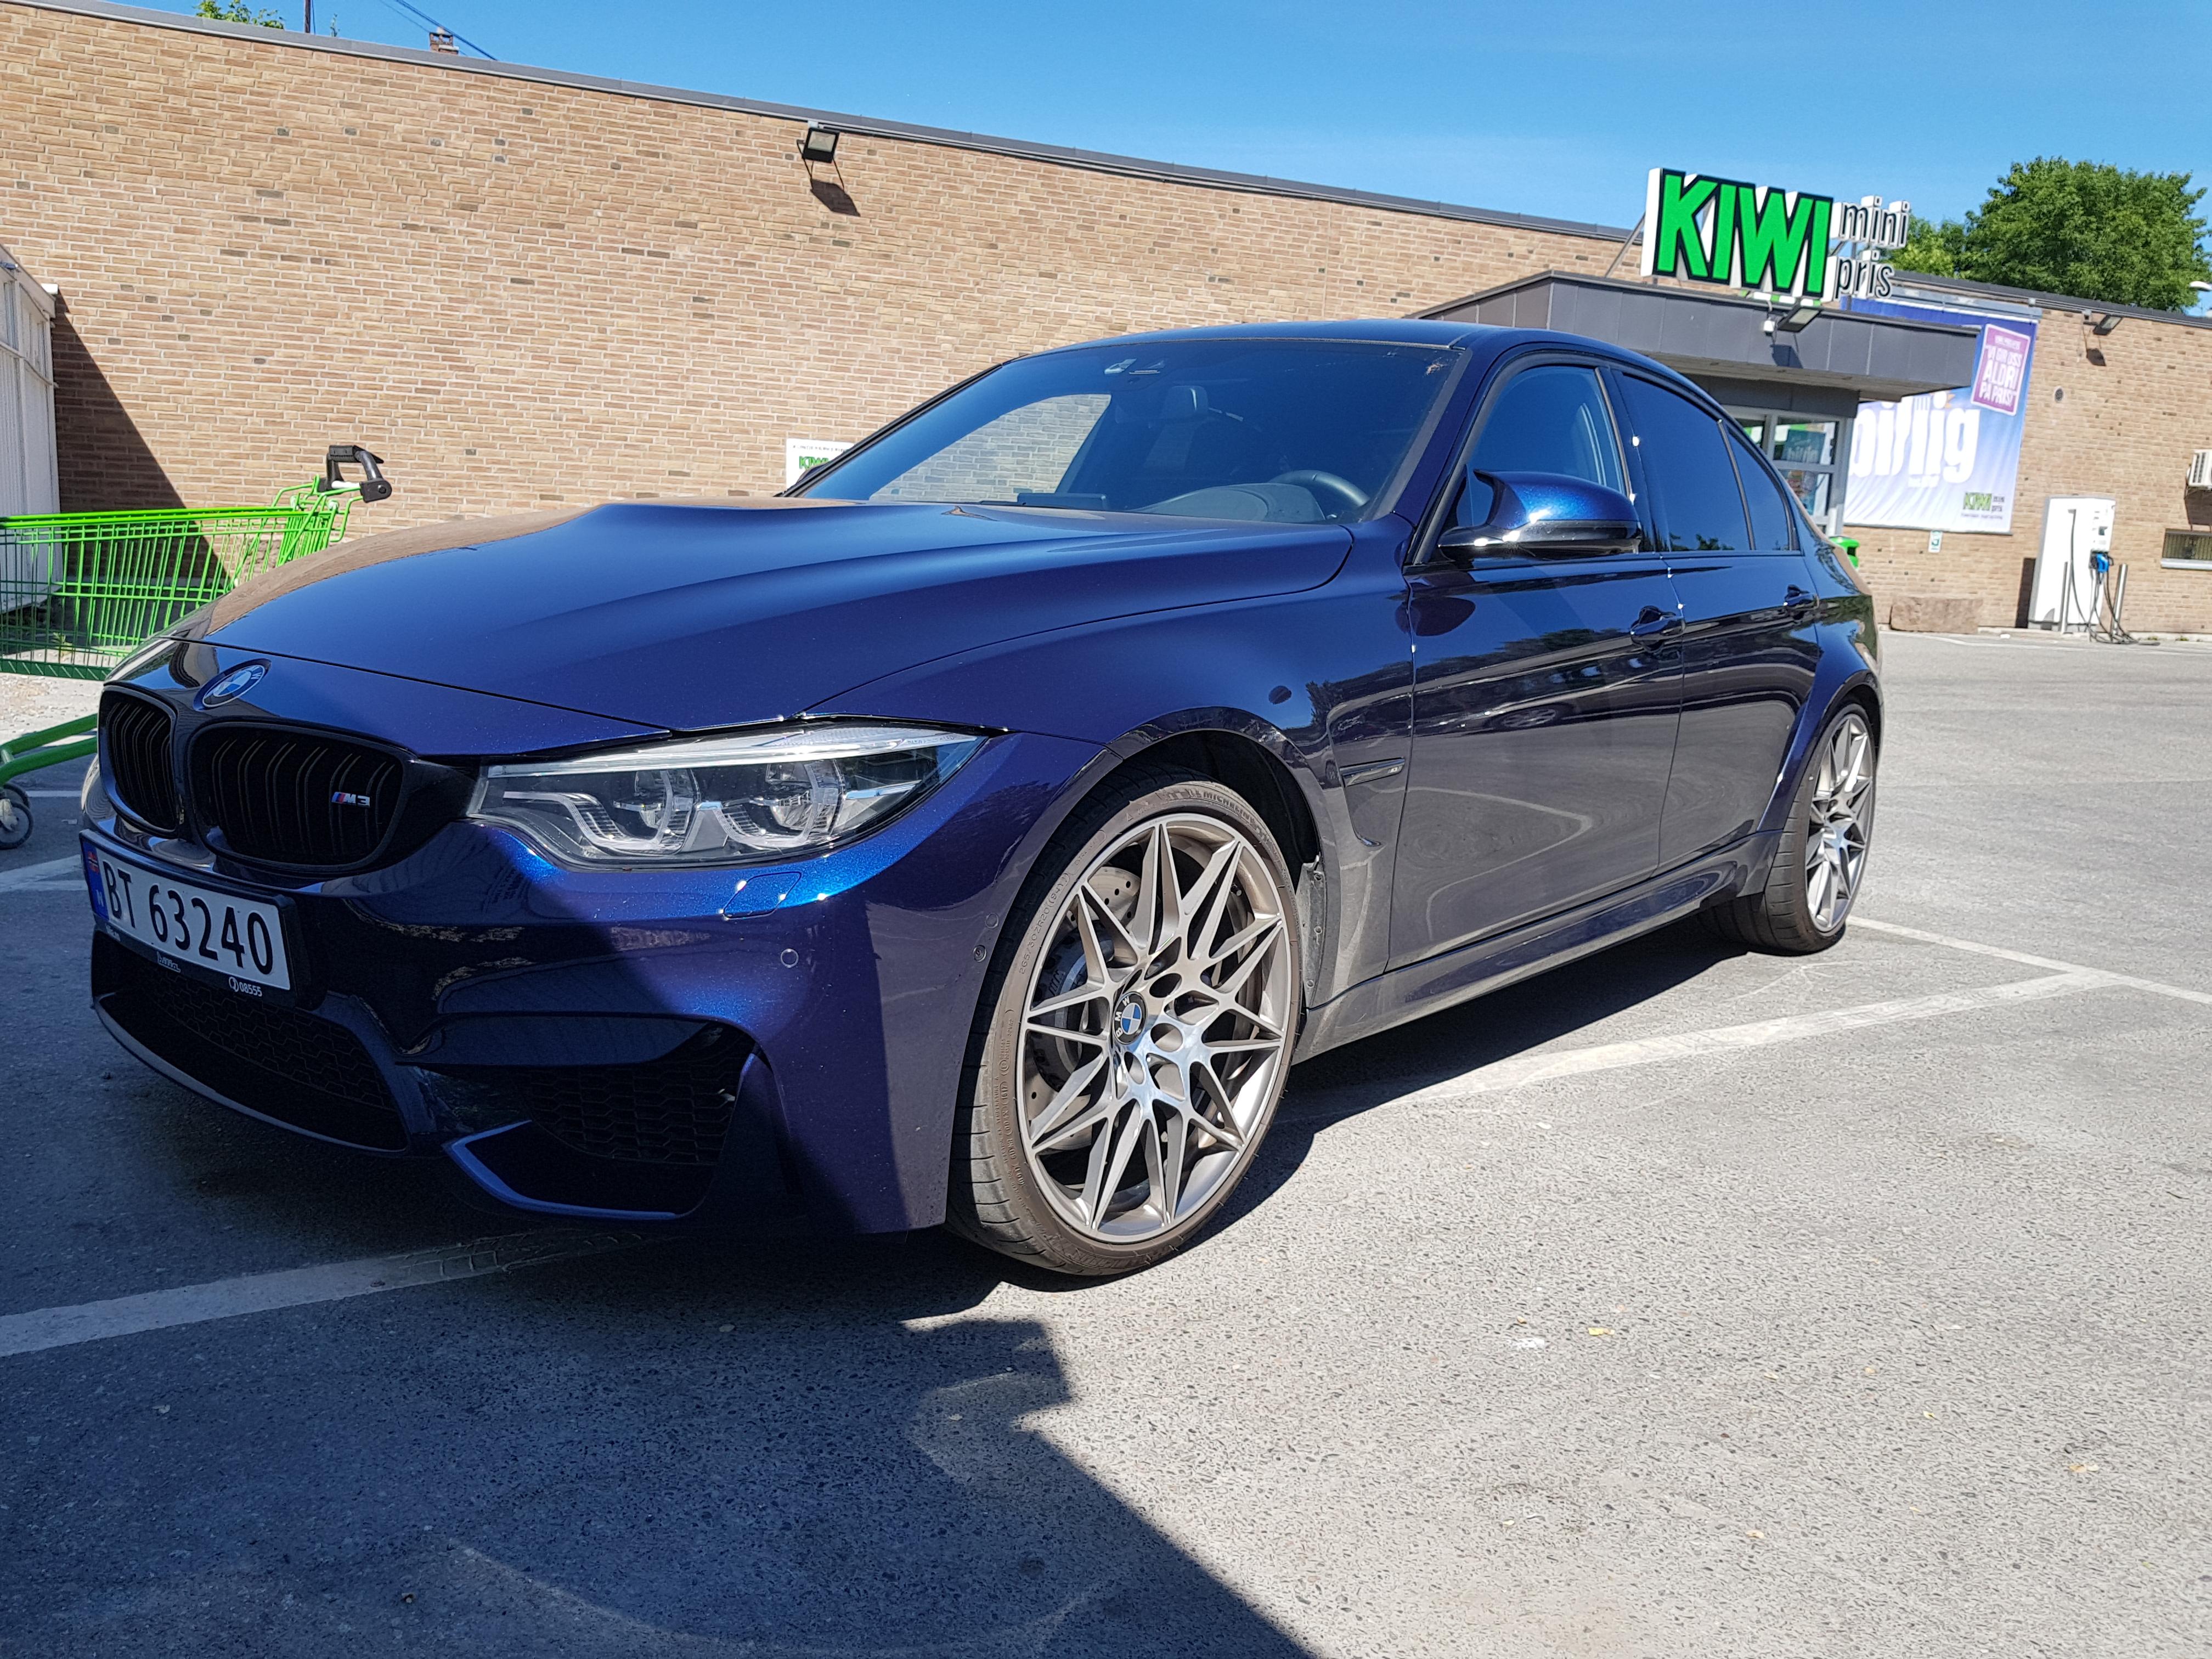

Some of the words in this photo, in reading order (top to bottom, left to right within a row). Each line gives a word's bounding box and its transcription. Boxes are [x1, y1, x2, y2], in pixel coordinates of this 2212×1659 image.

[1651, 168, 1833, 297] KIWI
[1841, 196, 1910, 247] mini
[1836, 251, 1894, 299] pris
[1983, 359, 2020, 390] ALDRI
[95, 889, 105, 907] N
[103, 861, 136, 929] BT
[149, 884, 273, 975] 63240
[239, 981, 263, 997] 08555
[1114, 996, 1130, 1038] BMW
